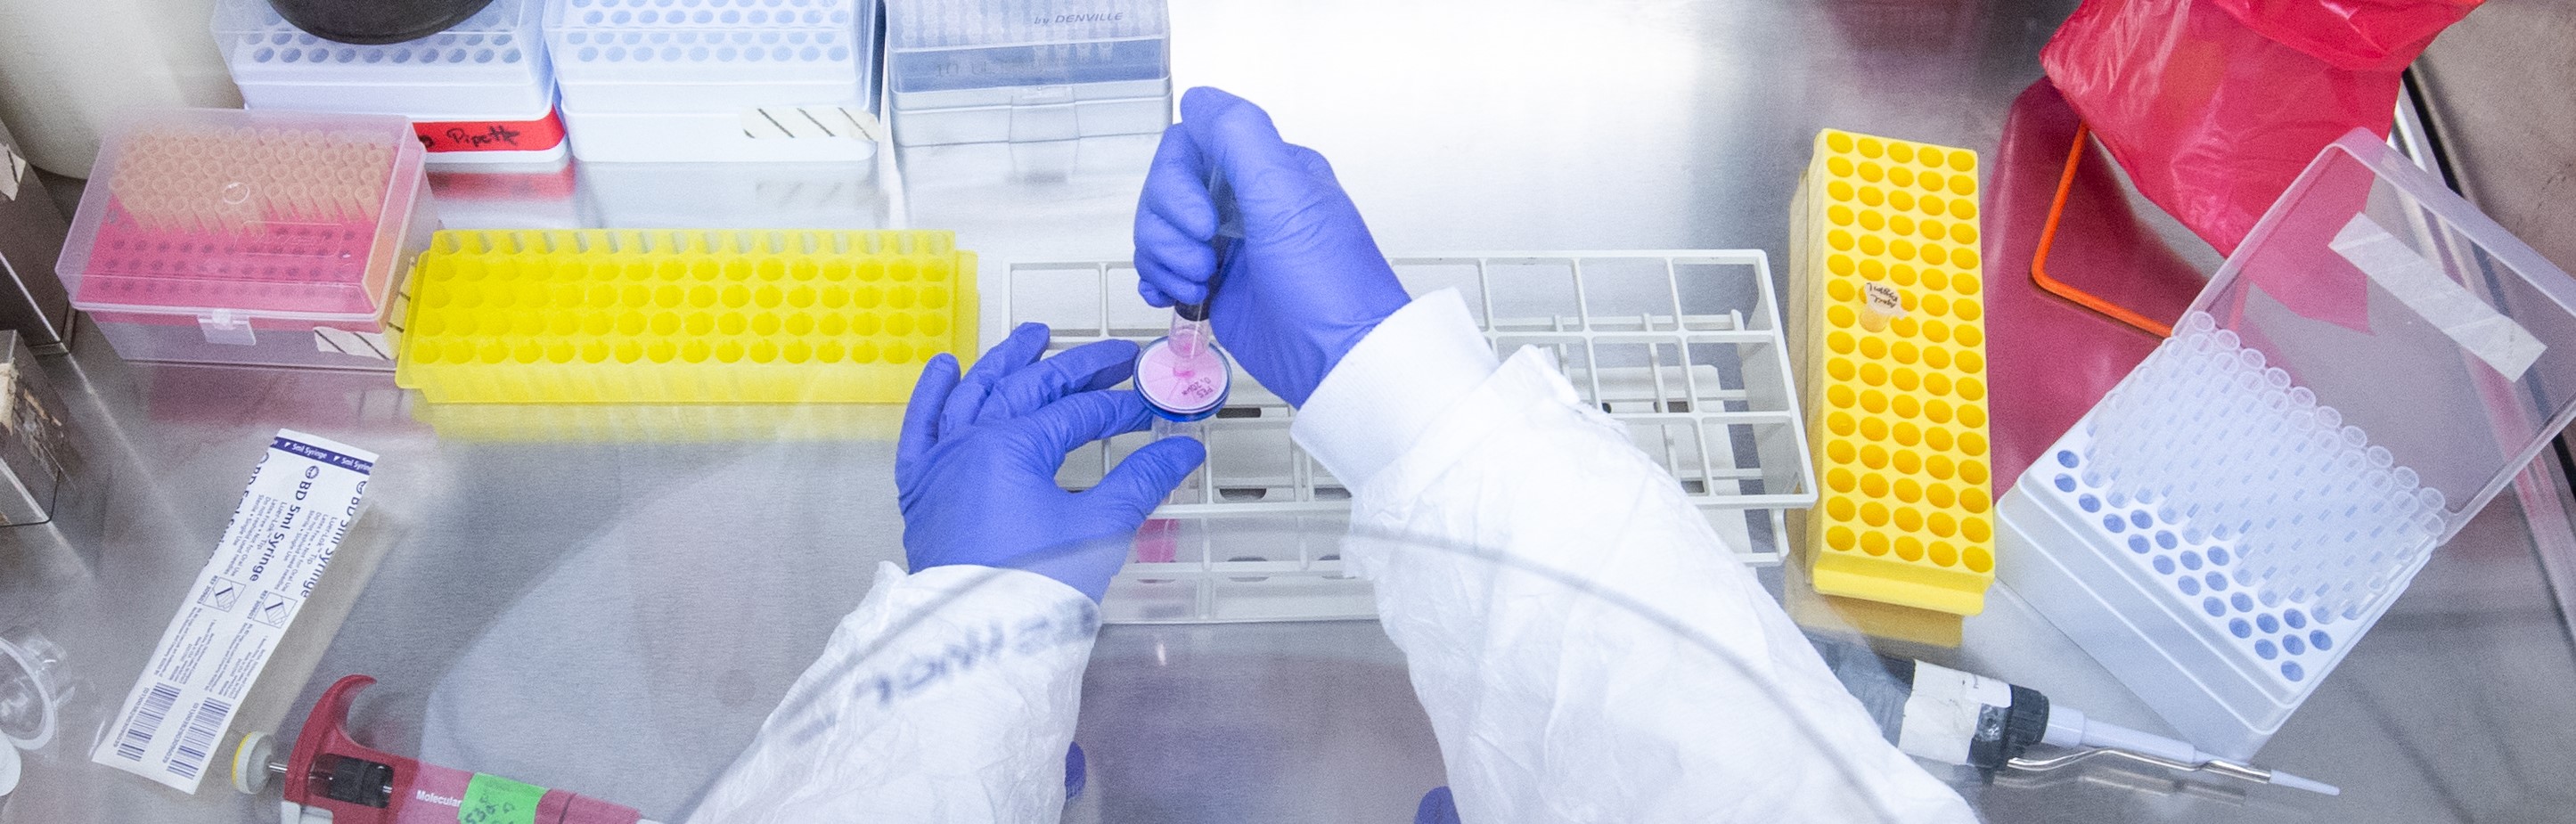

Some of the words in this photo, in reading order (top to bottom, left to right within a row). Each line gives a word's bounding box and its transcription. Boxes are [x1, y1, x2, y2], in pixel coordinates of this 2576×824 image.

[1054, 12, 1124, 24] DENVILLE
[295, 481, 311, 500] BD
[280, 505, 300, 528] 5ml
[249, 532, 284, 581] Syringe
[415, 789, 463, 808] Molecular
